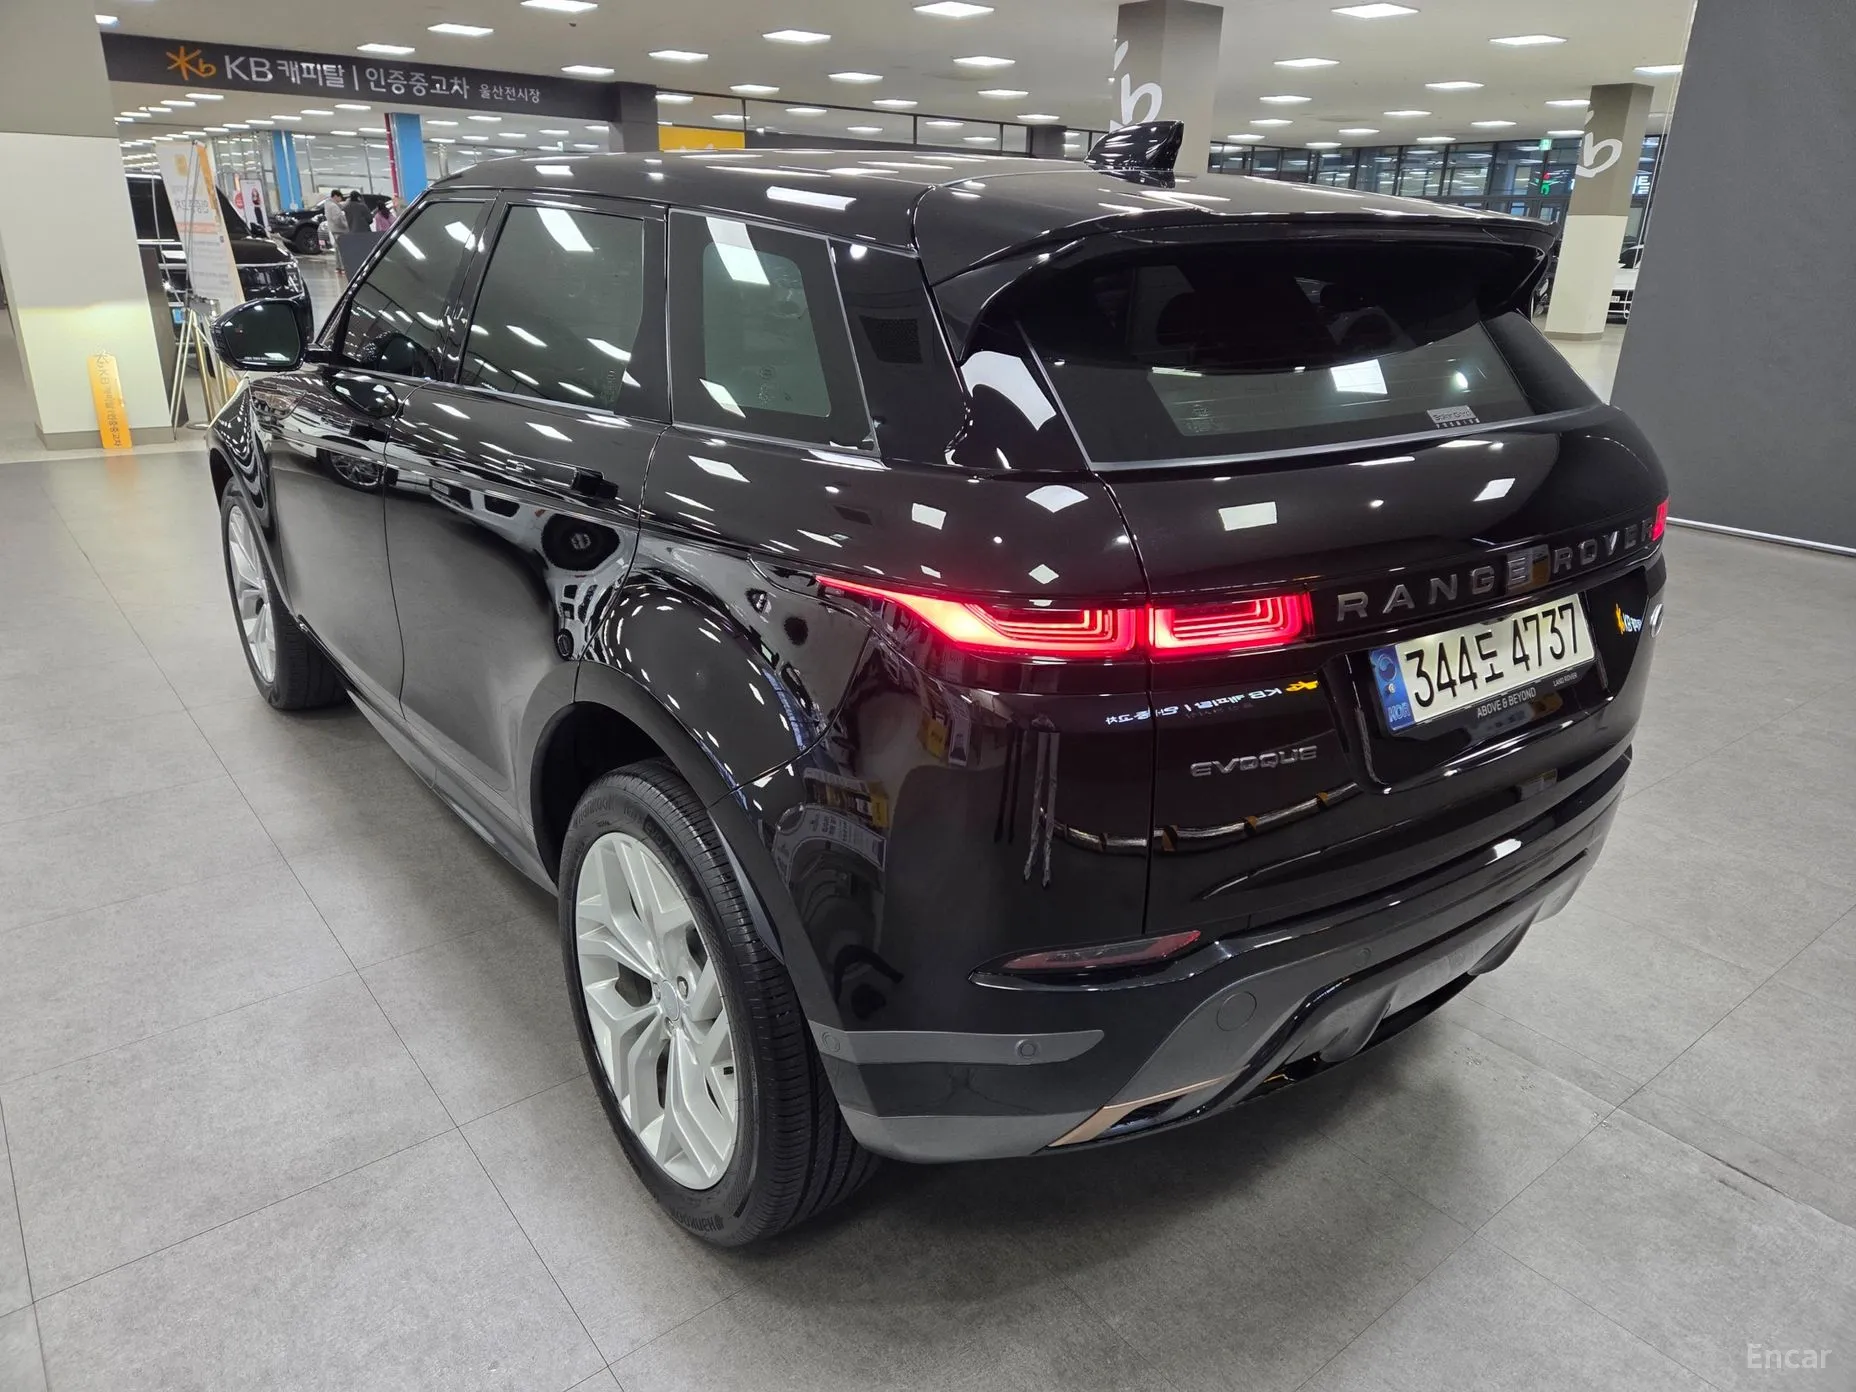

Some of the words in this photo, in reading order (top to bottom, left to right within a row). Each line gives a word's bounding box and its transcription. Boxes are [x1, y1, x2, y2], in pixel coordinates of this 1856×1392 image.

[224, 55, 274, 82] KB
[276, 60, 346, 89] 캐피탈
[365, 67, 470, 99] 인증중고차
[478, 83, 541, 104] 울산전시장
[1337, 555, 1530, 622] RANGE
[1553, 519, 1653, 574] ROVER
[1405, 630, 1504, 708] 344도
[1512, 602, 1578, 672] 4737
[1477, 698, 1503, 718] ABOVE
[1508, 687, 1537, 706] BEYOND
[1190, 746, 1318, 777] EVOQUE
